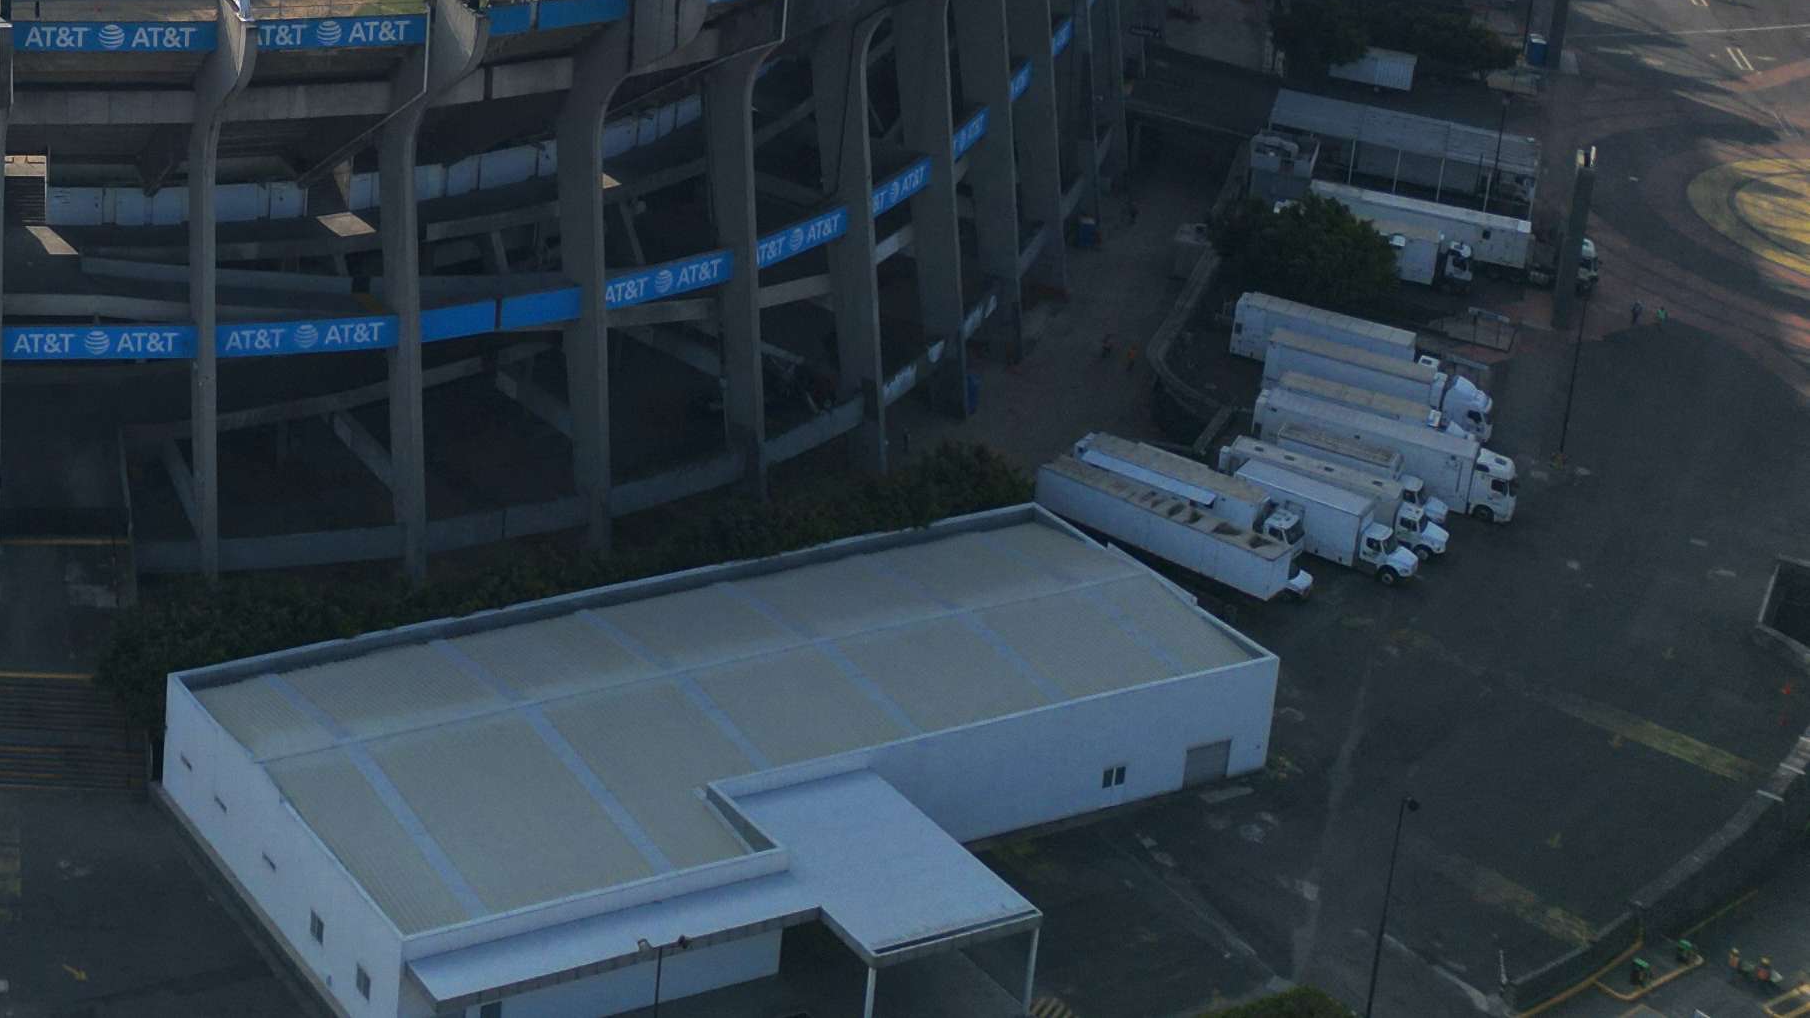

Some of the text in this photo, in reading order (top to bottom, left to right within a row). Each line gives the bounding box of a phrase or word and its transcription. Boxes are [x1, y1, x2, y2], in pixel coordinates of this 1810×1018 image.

[25, 26, 197, 48] AT&T AT&T
[349, 20, 411, 43] AT&T
[807, 214, 840, 243] AT&T
[605, 259, 722, 303] AT&T AT&T
[13, 332, 179, 354] AT&T AT&T
[226, 322, 385, 351] AT&T AT&T
